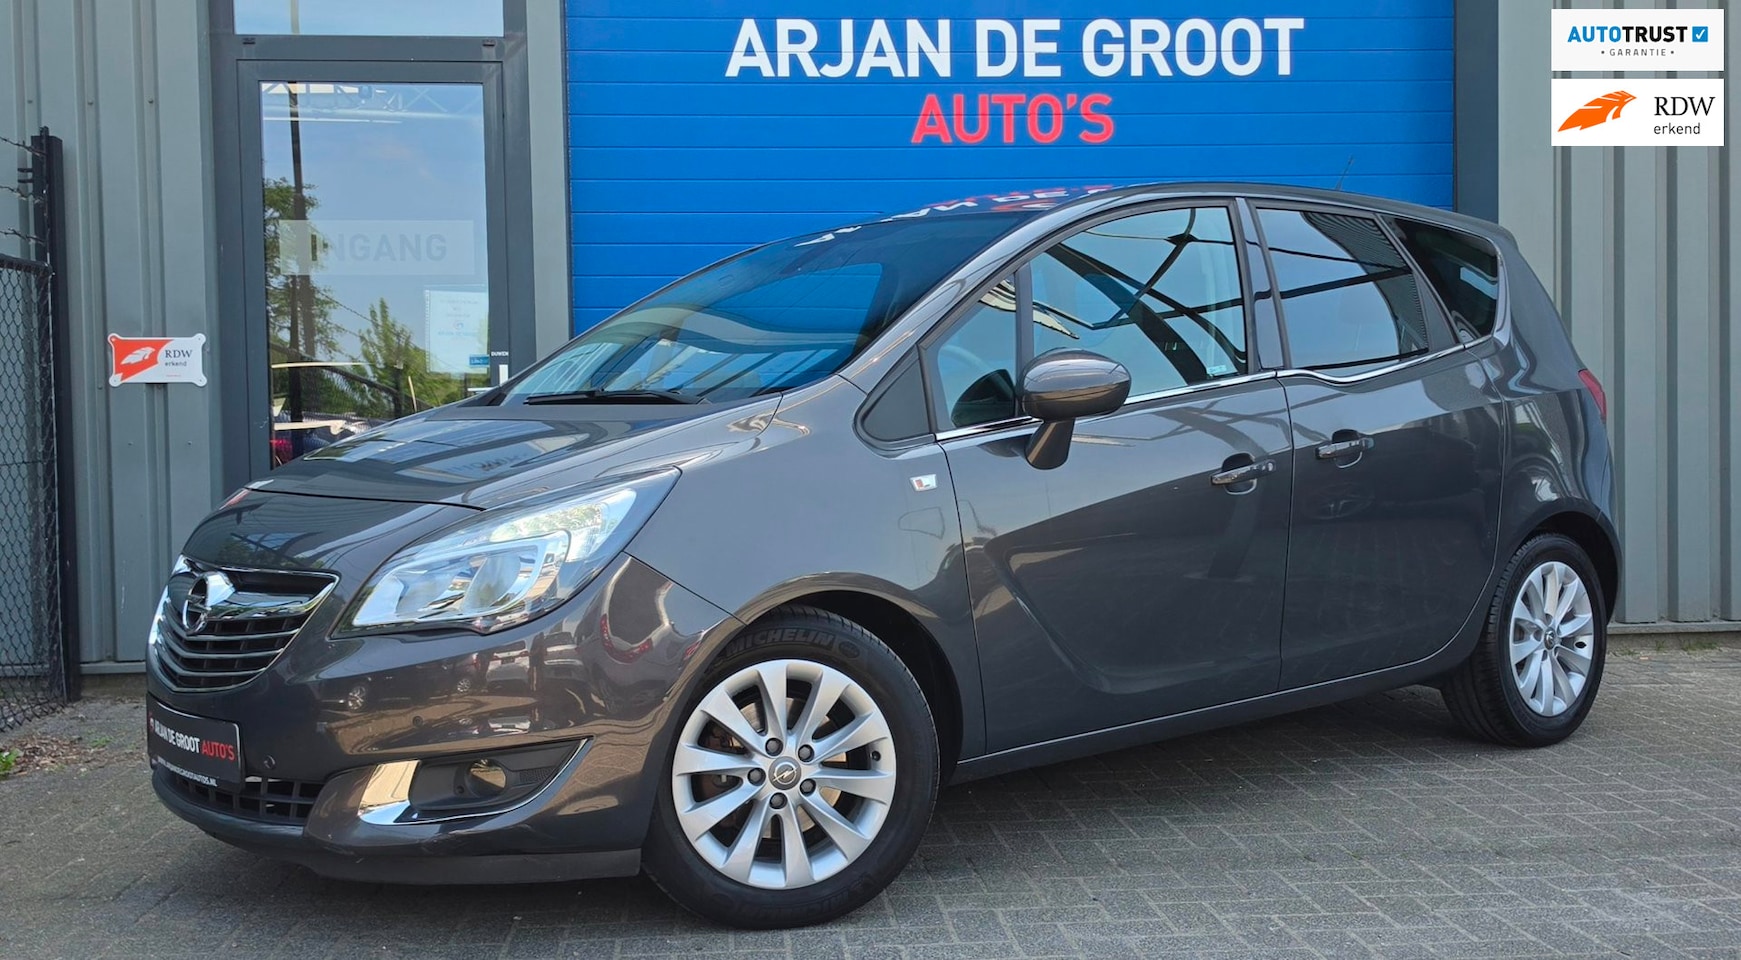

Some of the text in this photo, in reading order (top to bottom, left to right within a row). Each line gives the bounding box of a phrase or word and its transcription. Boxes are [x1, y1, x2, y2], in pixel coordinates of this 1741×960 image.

[725, 18, 1305, 78] ARJAN DE GROOT
[911, 93, 1114, 143] AUTO'S
[164, 349, 193, 359] RDW
[726, 628, 834, 657] MICHELIN
[175, 731, 200, 753] GROOT
[201, 740, 236, 761] AUTO'S
